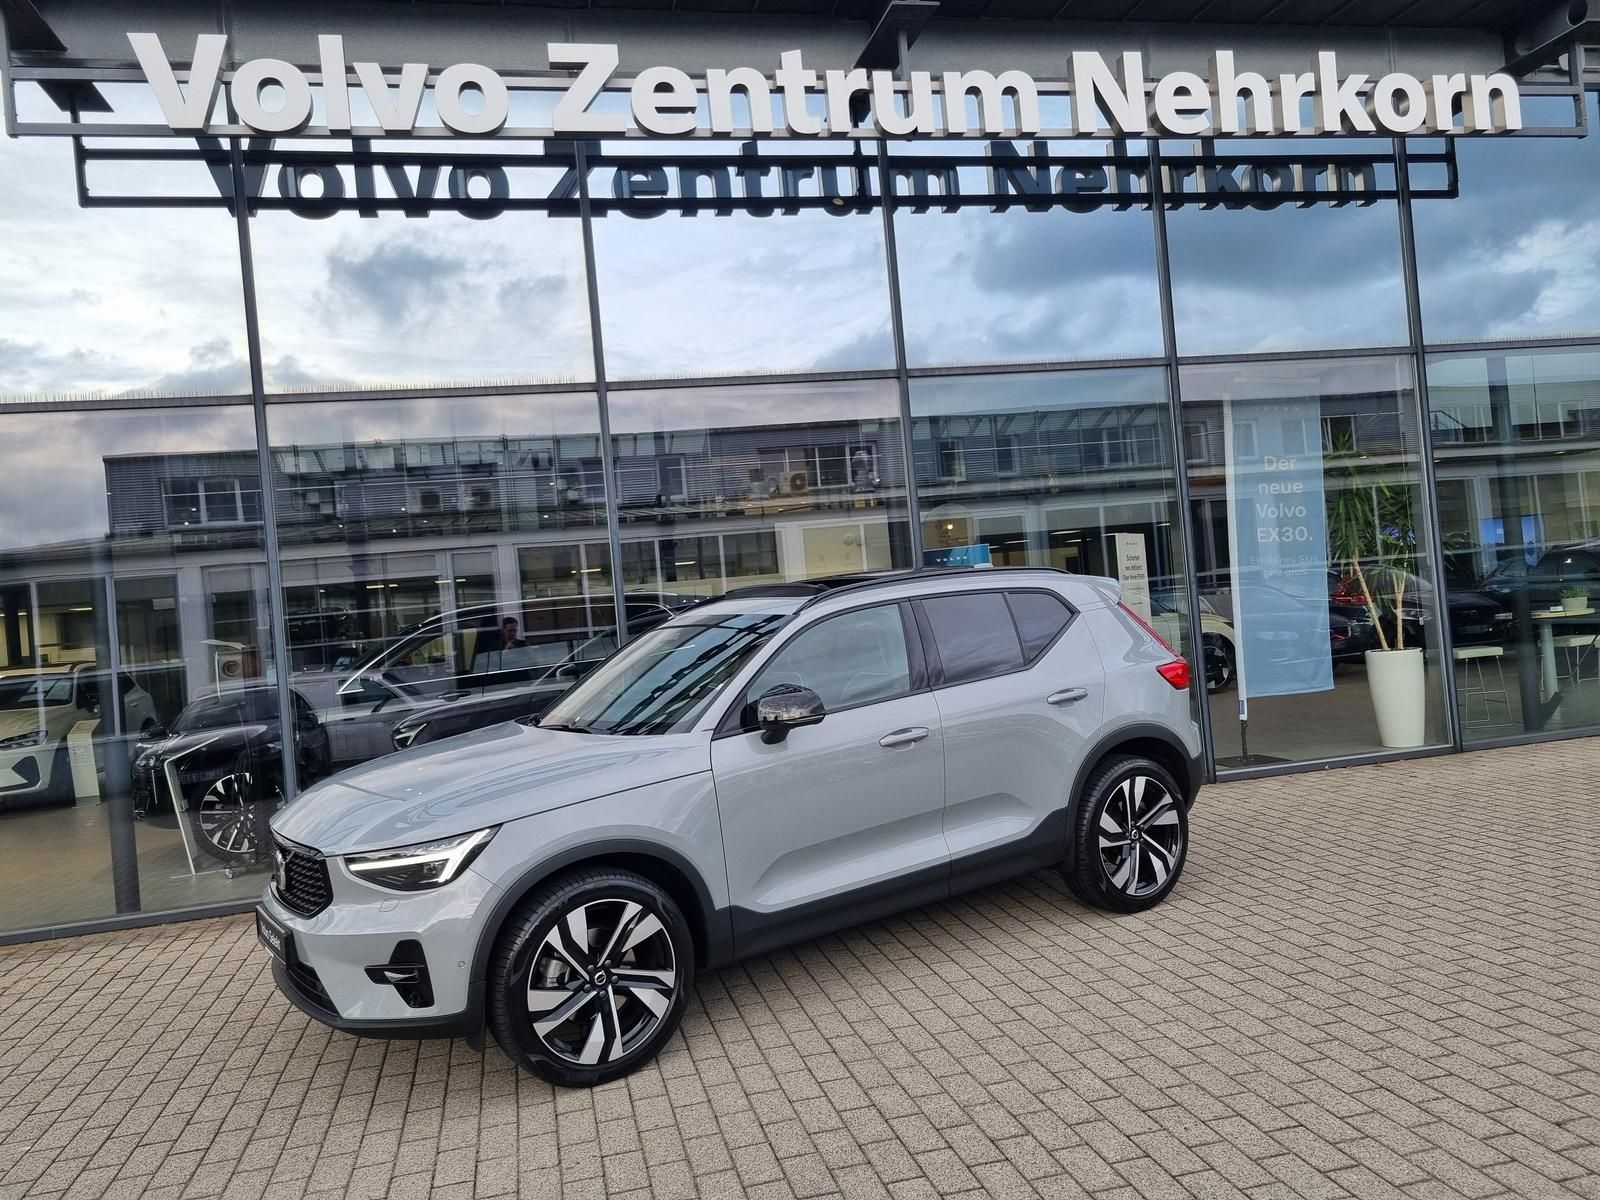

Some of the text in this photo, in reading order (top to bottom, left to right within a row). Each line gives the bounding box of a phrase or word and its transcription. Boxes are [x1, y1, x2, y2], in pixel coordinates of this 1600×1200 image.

[127, 32, 1522, 137] Volvo Zentrum Nehrkorn
[1263, 456, 1297, 471] Der
[1258, 481, 1304, 495] neue
[1256, 503, 1306, 519] Volvo
[1257, 526, 1313, 542] EX30.
